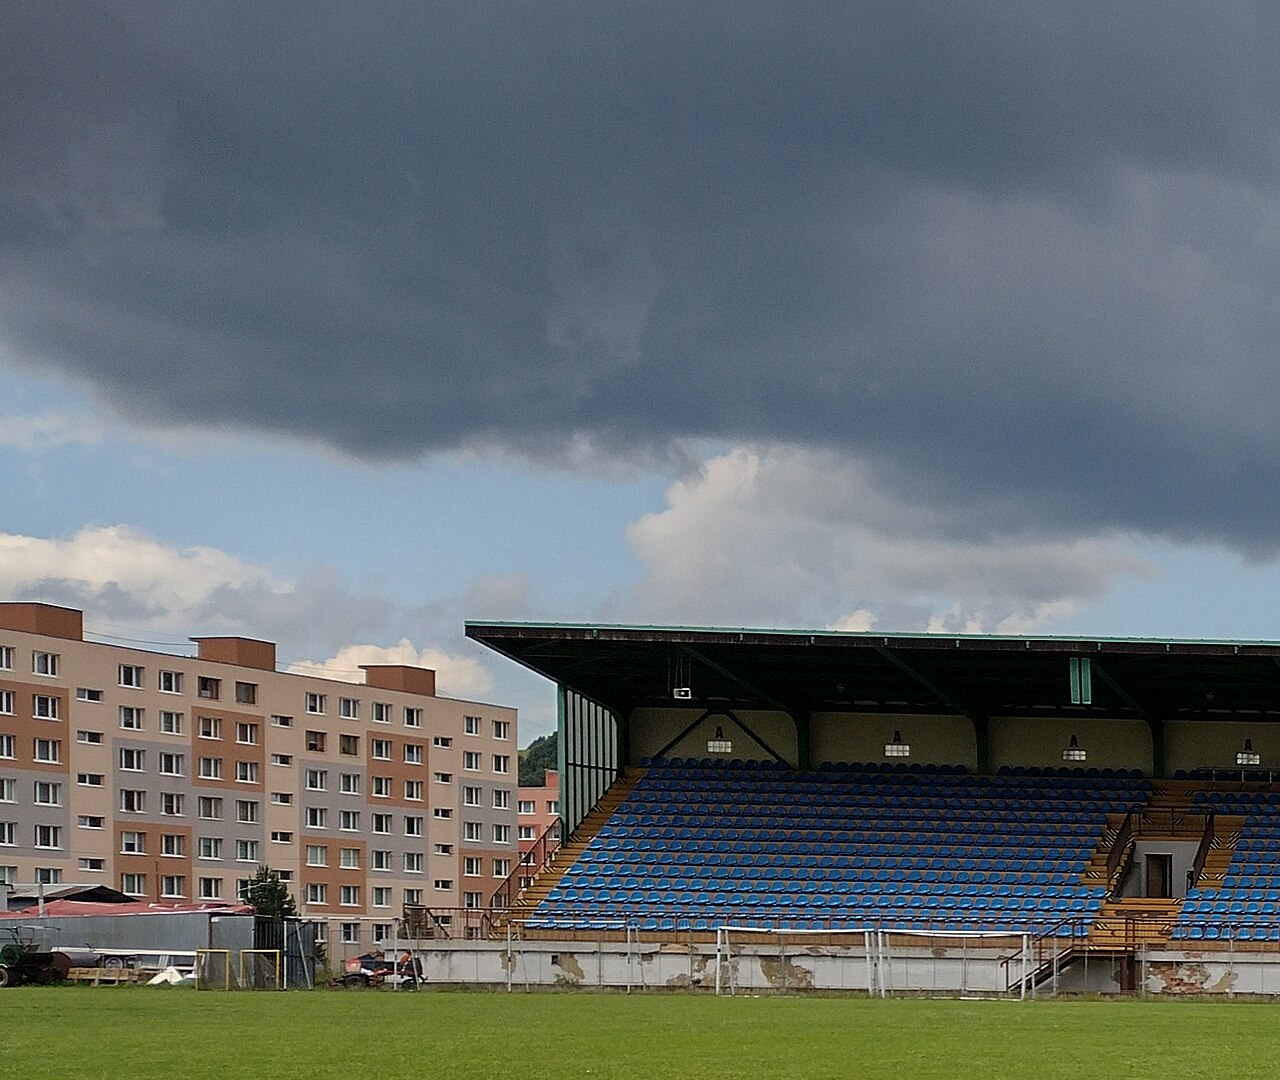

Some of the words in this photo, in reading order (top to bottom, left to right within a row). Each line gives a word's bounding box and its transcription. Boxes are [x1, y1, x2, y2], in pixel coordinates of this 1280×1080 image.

[715, 726, 724, 738] A
[892, 730, 902, 743] A
[1069, 734, 1079, 747] A
[1244, 738, 1253, 751] A
